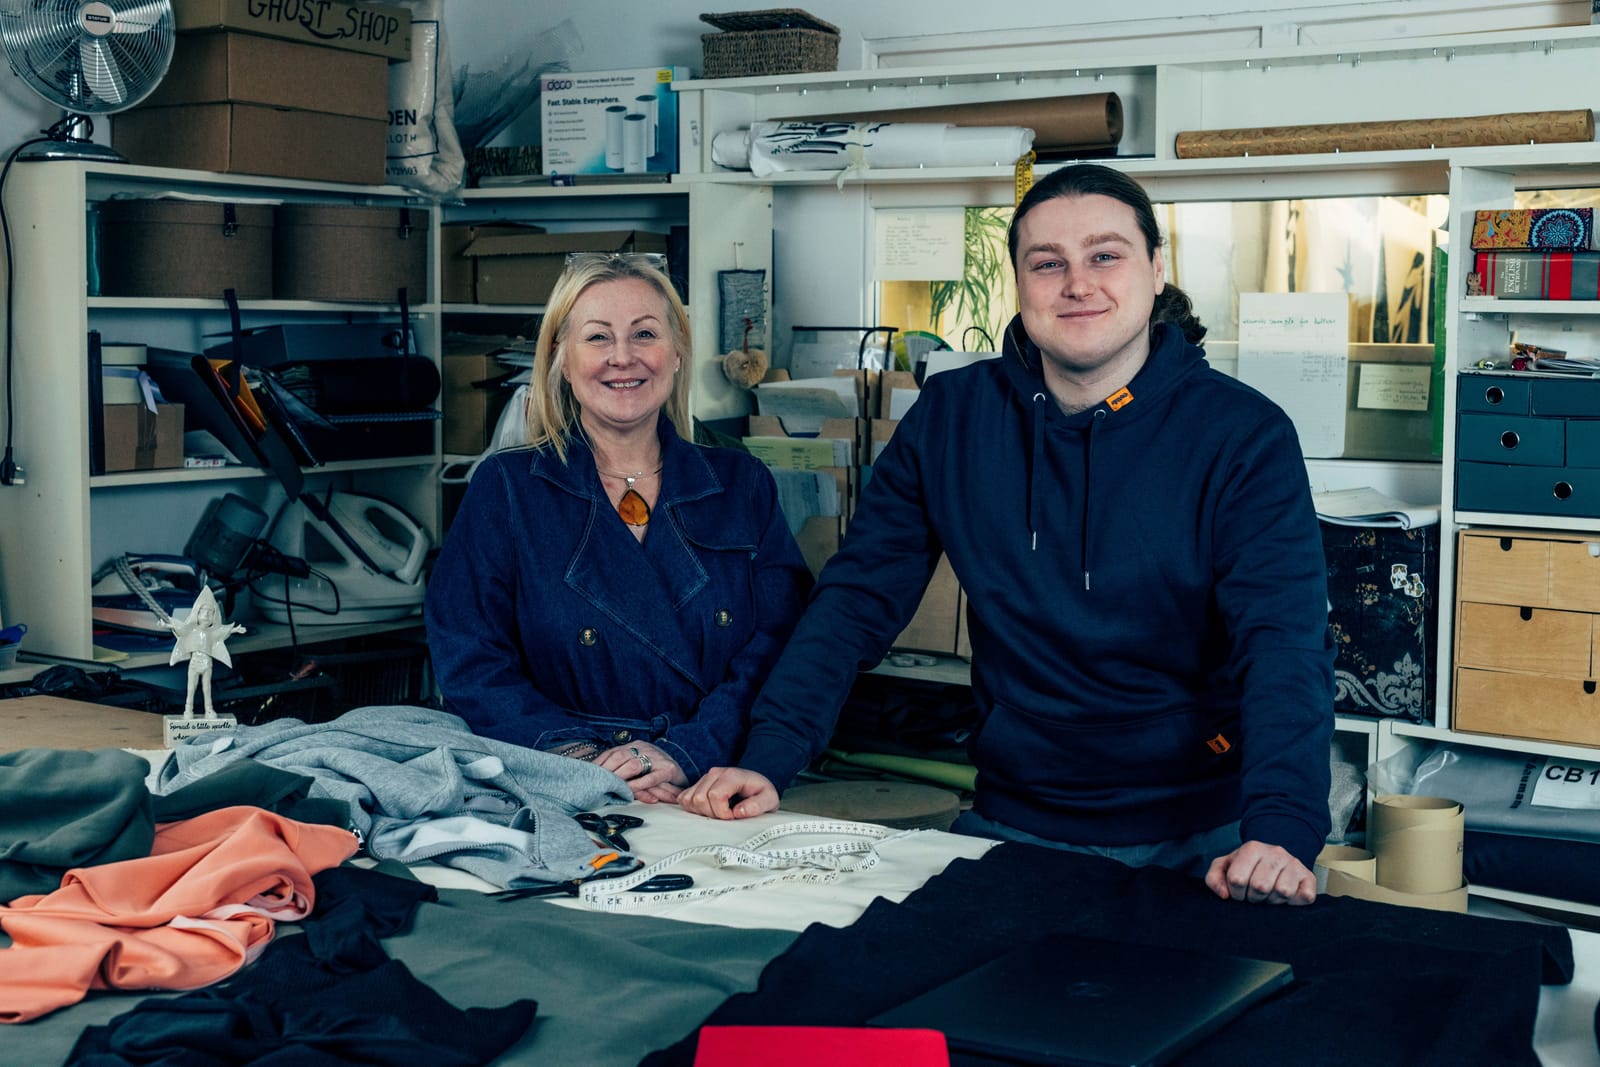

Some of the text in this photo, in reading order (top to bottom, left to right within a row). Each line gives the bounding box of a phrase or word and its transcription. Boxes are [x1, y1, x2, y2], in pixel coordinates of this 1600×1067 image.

[248, 0, 399, 45] GHOST SHOP
[388, 134, 416, 143] LOTH
[169, 722, 190, 732] Spread
[197, 722, 211, 730] little
[607, 897, 623, 905] 32
[633, 895, 646, 903] 31
[653, 894, 670, 902] 30
